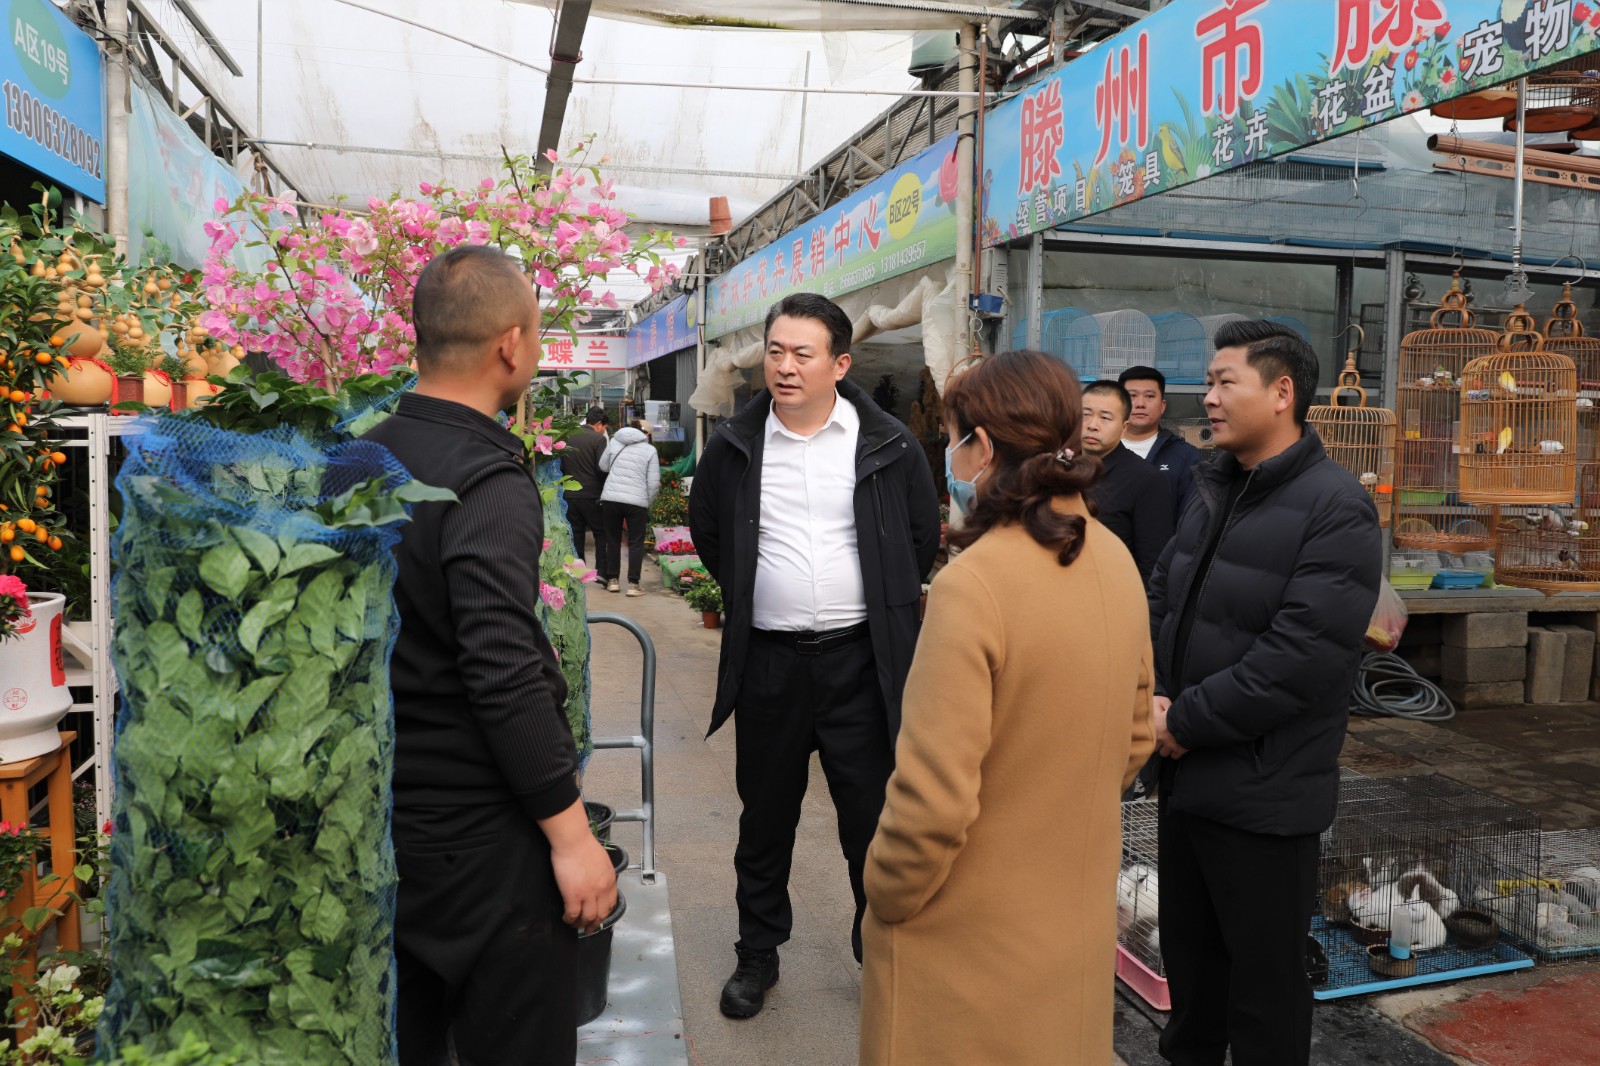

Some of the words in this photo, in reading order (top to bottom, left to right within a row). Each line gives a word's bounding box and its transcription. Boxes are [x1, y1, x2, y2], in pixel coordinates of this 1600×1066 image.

[14, 16, 70, 86] A区19号
[2, 79, 103, 181] 13906328092
[1117, 151, 1161, 197] 笼具
[1212, 109, 1269, 167] 花卉
[1318, 62, 1396, 130] 花盆
[1461, 0, 1600, 82] 宠物
[889, 188, 921, 224] B区22号
